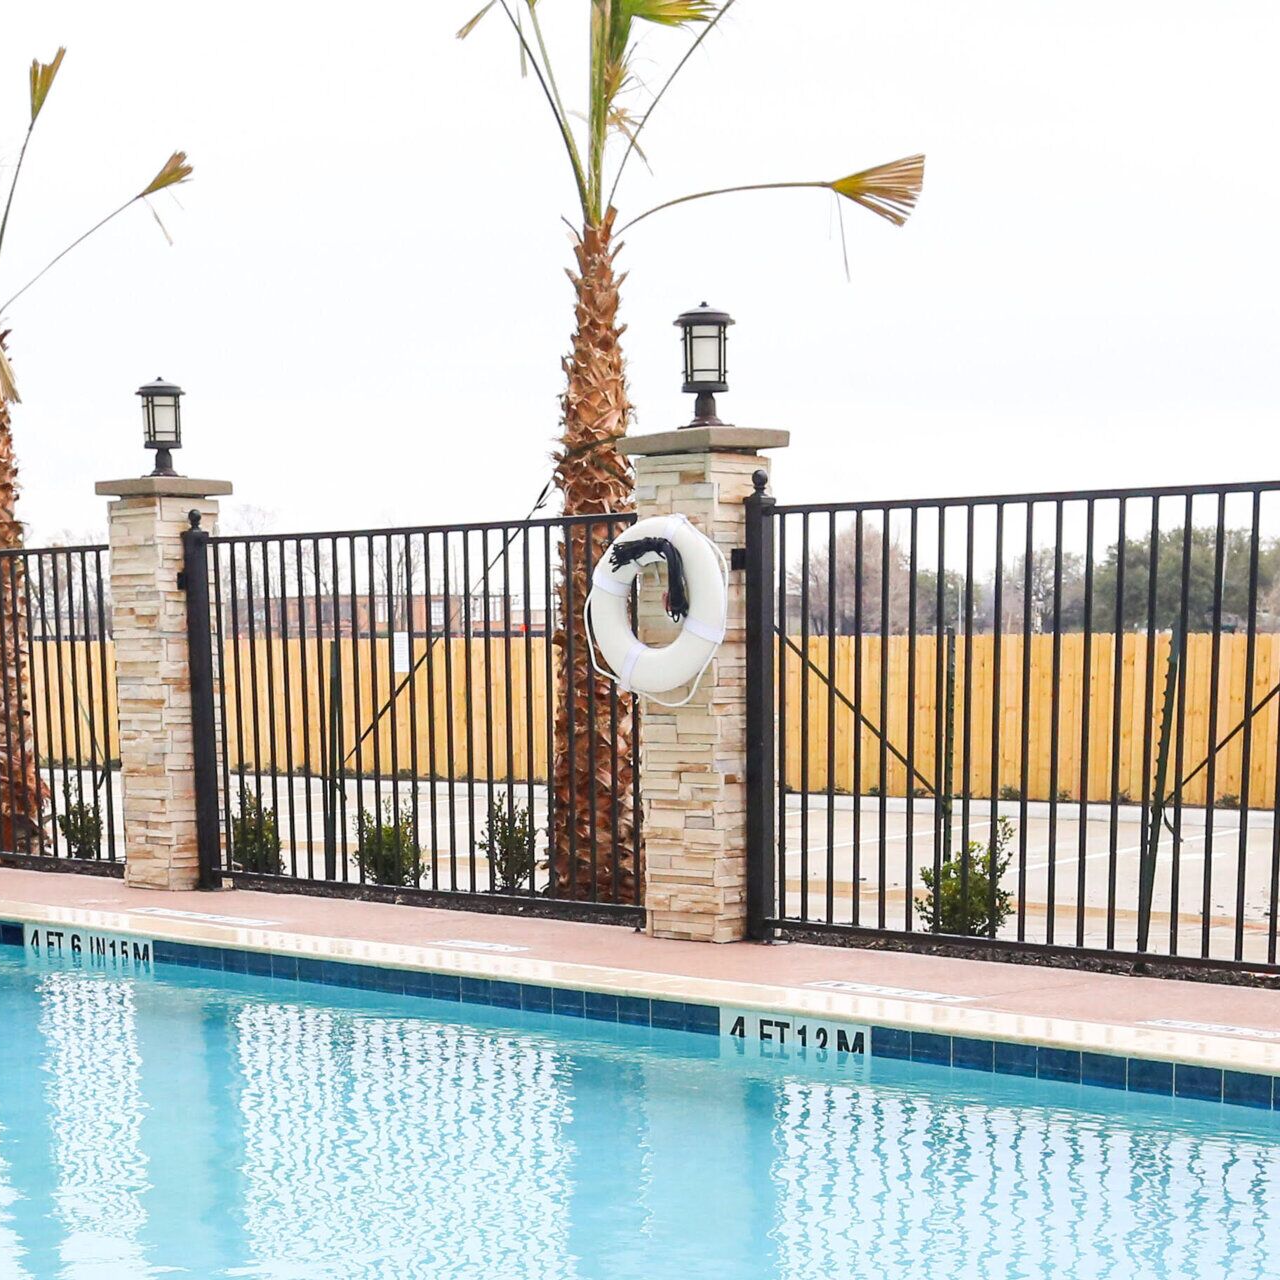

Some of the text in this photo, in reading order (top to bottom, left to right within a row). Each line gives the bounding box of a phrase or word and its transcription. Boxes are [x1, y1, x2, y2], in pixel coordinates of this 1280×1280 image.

[71, 933, 82, 953] 6
[133, 942, 150, 962] M
[759, 1018, 790, 1044] FT
[836, 1029, 865, 1055] M
